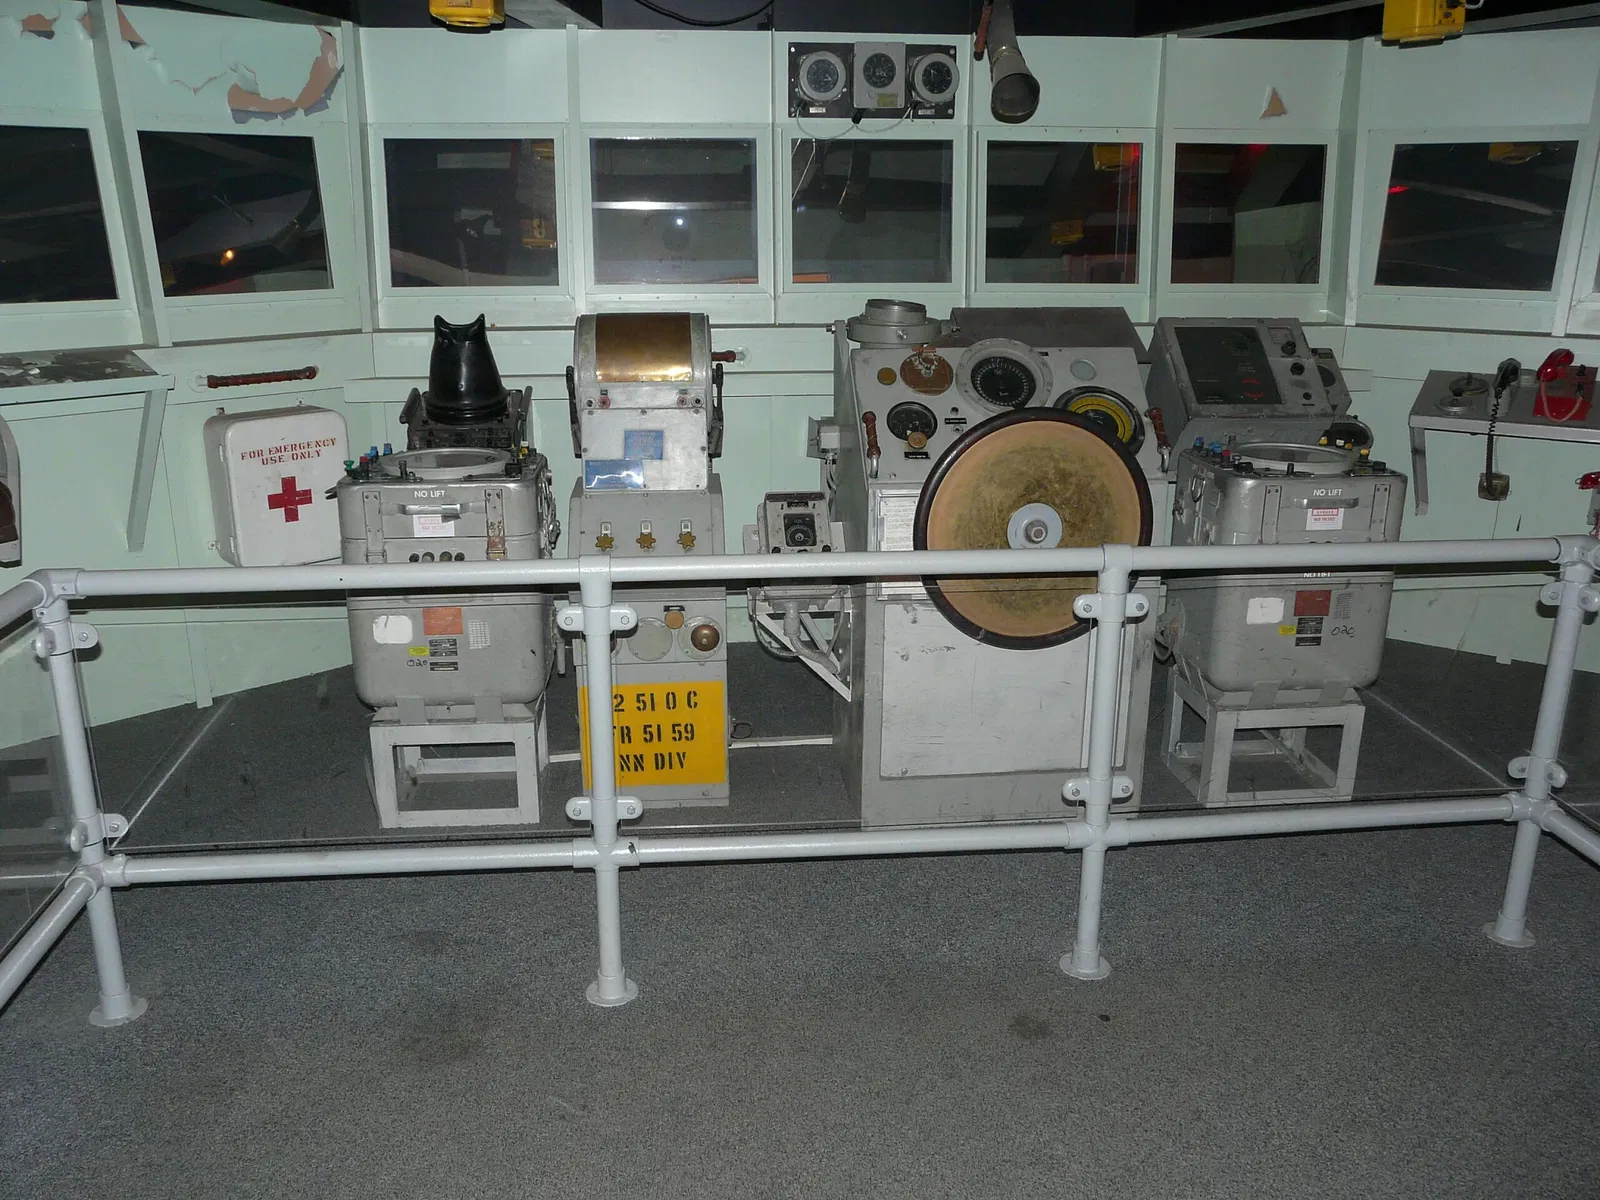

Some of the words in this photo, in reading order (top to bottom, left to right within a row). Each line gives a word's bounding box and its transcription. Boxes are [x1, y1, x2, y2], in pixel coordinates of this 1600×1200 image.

[241, 449, 264, 461] FOR
[268, 437, 336, 456] EMERGENCY
[261, 454, 285, 466] USE
[291, 449, 322, 461] ONLY
[413, 490, 428, 498] NO
[430, 490, 445, 498] LIFT
[1313, 488, 1326, 496] NO
[1328, 488, 1343, 496] LIFT
[686, 690, 698, 709] C
[671, 723, 695, 742] 59
[654, 752, 686, 770] DIV
